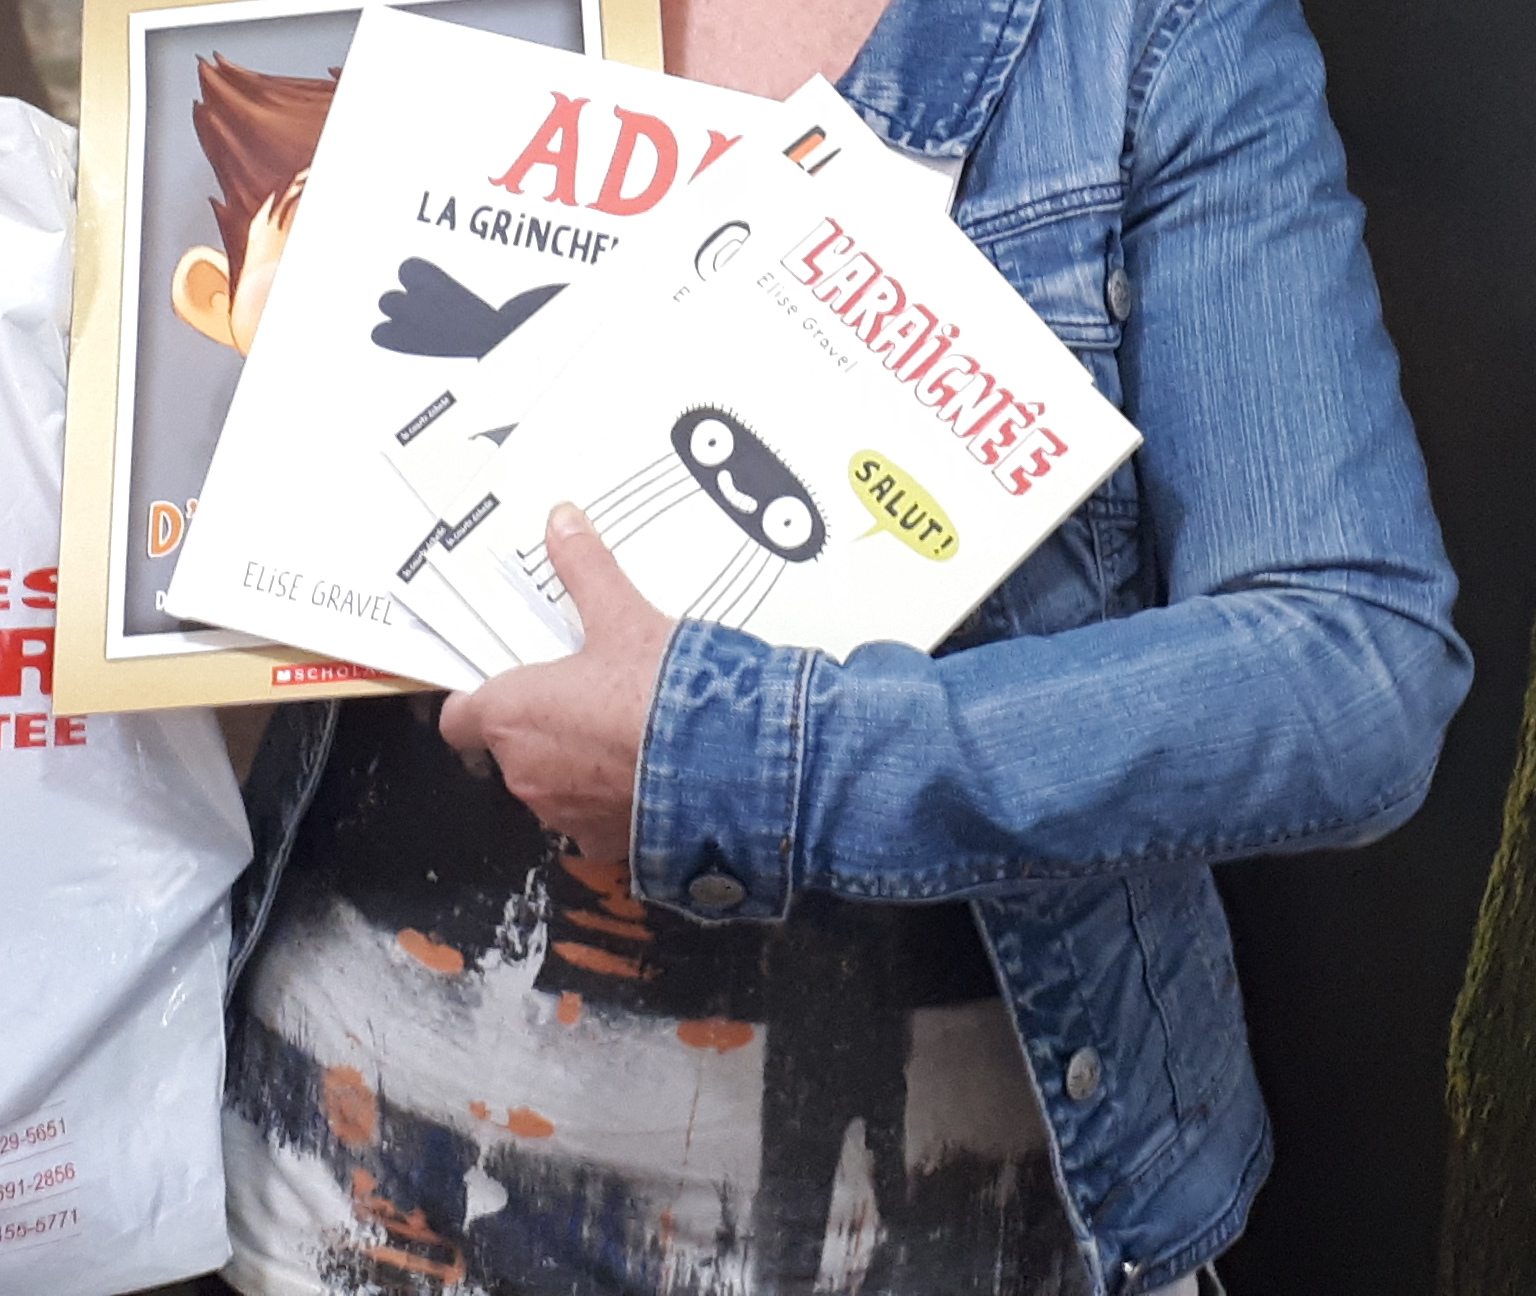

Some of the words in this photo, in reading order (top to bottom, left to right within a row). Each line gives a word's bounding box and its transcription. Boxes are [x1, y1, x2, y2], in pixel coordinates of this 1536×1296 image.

[416, 190, 457, 232] LA
[756, 271, 799, 316] Elise
[802, 317, 859, 374] Gravel
[853, 459, 954, 554] SALUT!
[311, 580, 393, 626] GRAVEL
